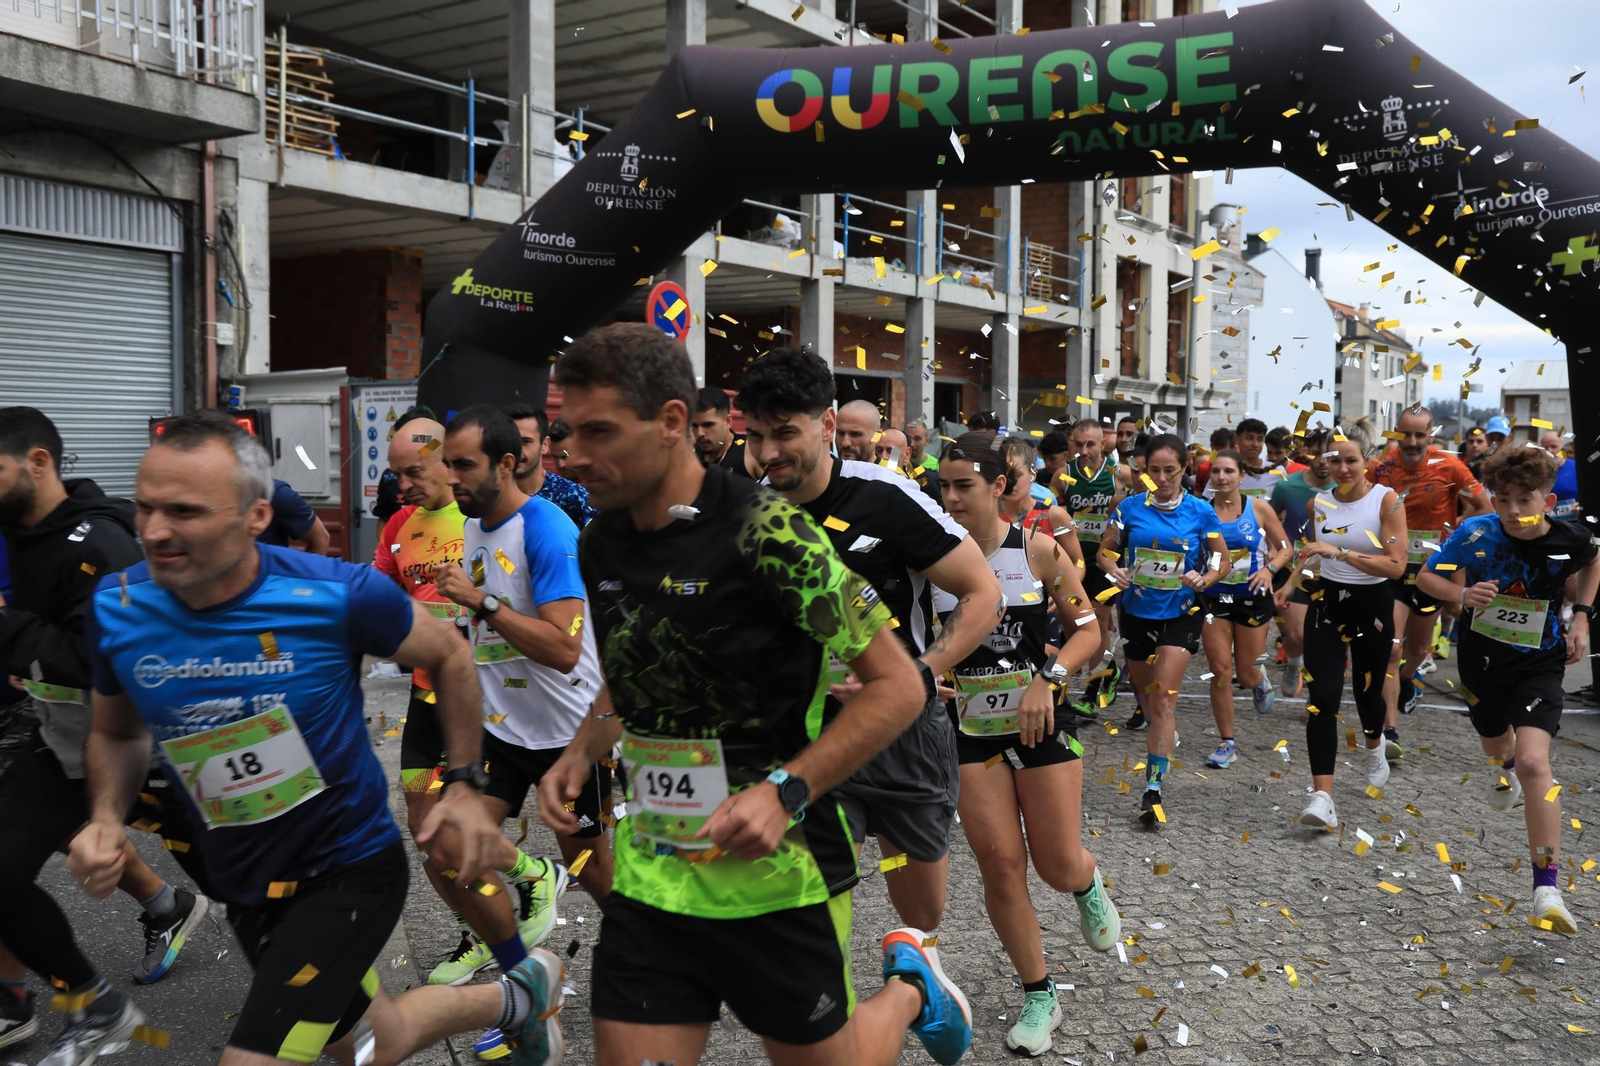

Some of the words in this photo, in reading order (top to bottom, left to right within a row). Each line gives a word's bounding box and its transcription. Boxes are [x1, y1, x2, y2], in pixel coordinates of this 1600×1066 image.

[755, 31, 1238, 133] OURENSE
[1056, 116, 1239, 155] NATURAL
[1472, 186, 1550, 213] inorde
[1475, 214, 1535, 233] turismo
[1538, 202, 1600, 222] Ourense
[526, 228, 576, 248] inorde
[523, 249, 563, 264] turismo
[565, 253, 616, 266] Ourense
[480, 297, 494, 308] La
[1084, 522, 1101, 530] 214
[1153, 562, 1168, 572] 74
[1496, 609, 1529, 624] 223
[991, 639, 1011, 648] fresh
[986, 693, 1009, 709] 97
[224, 752, 263, 781] 18
[646, 770, 695, 799] 194
